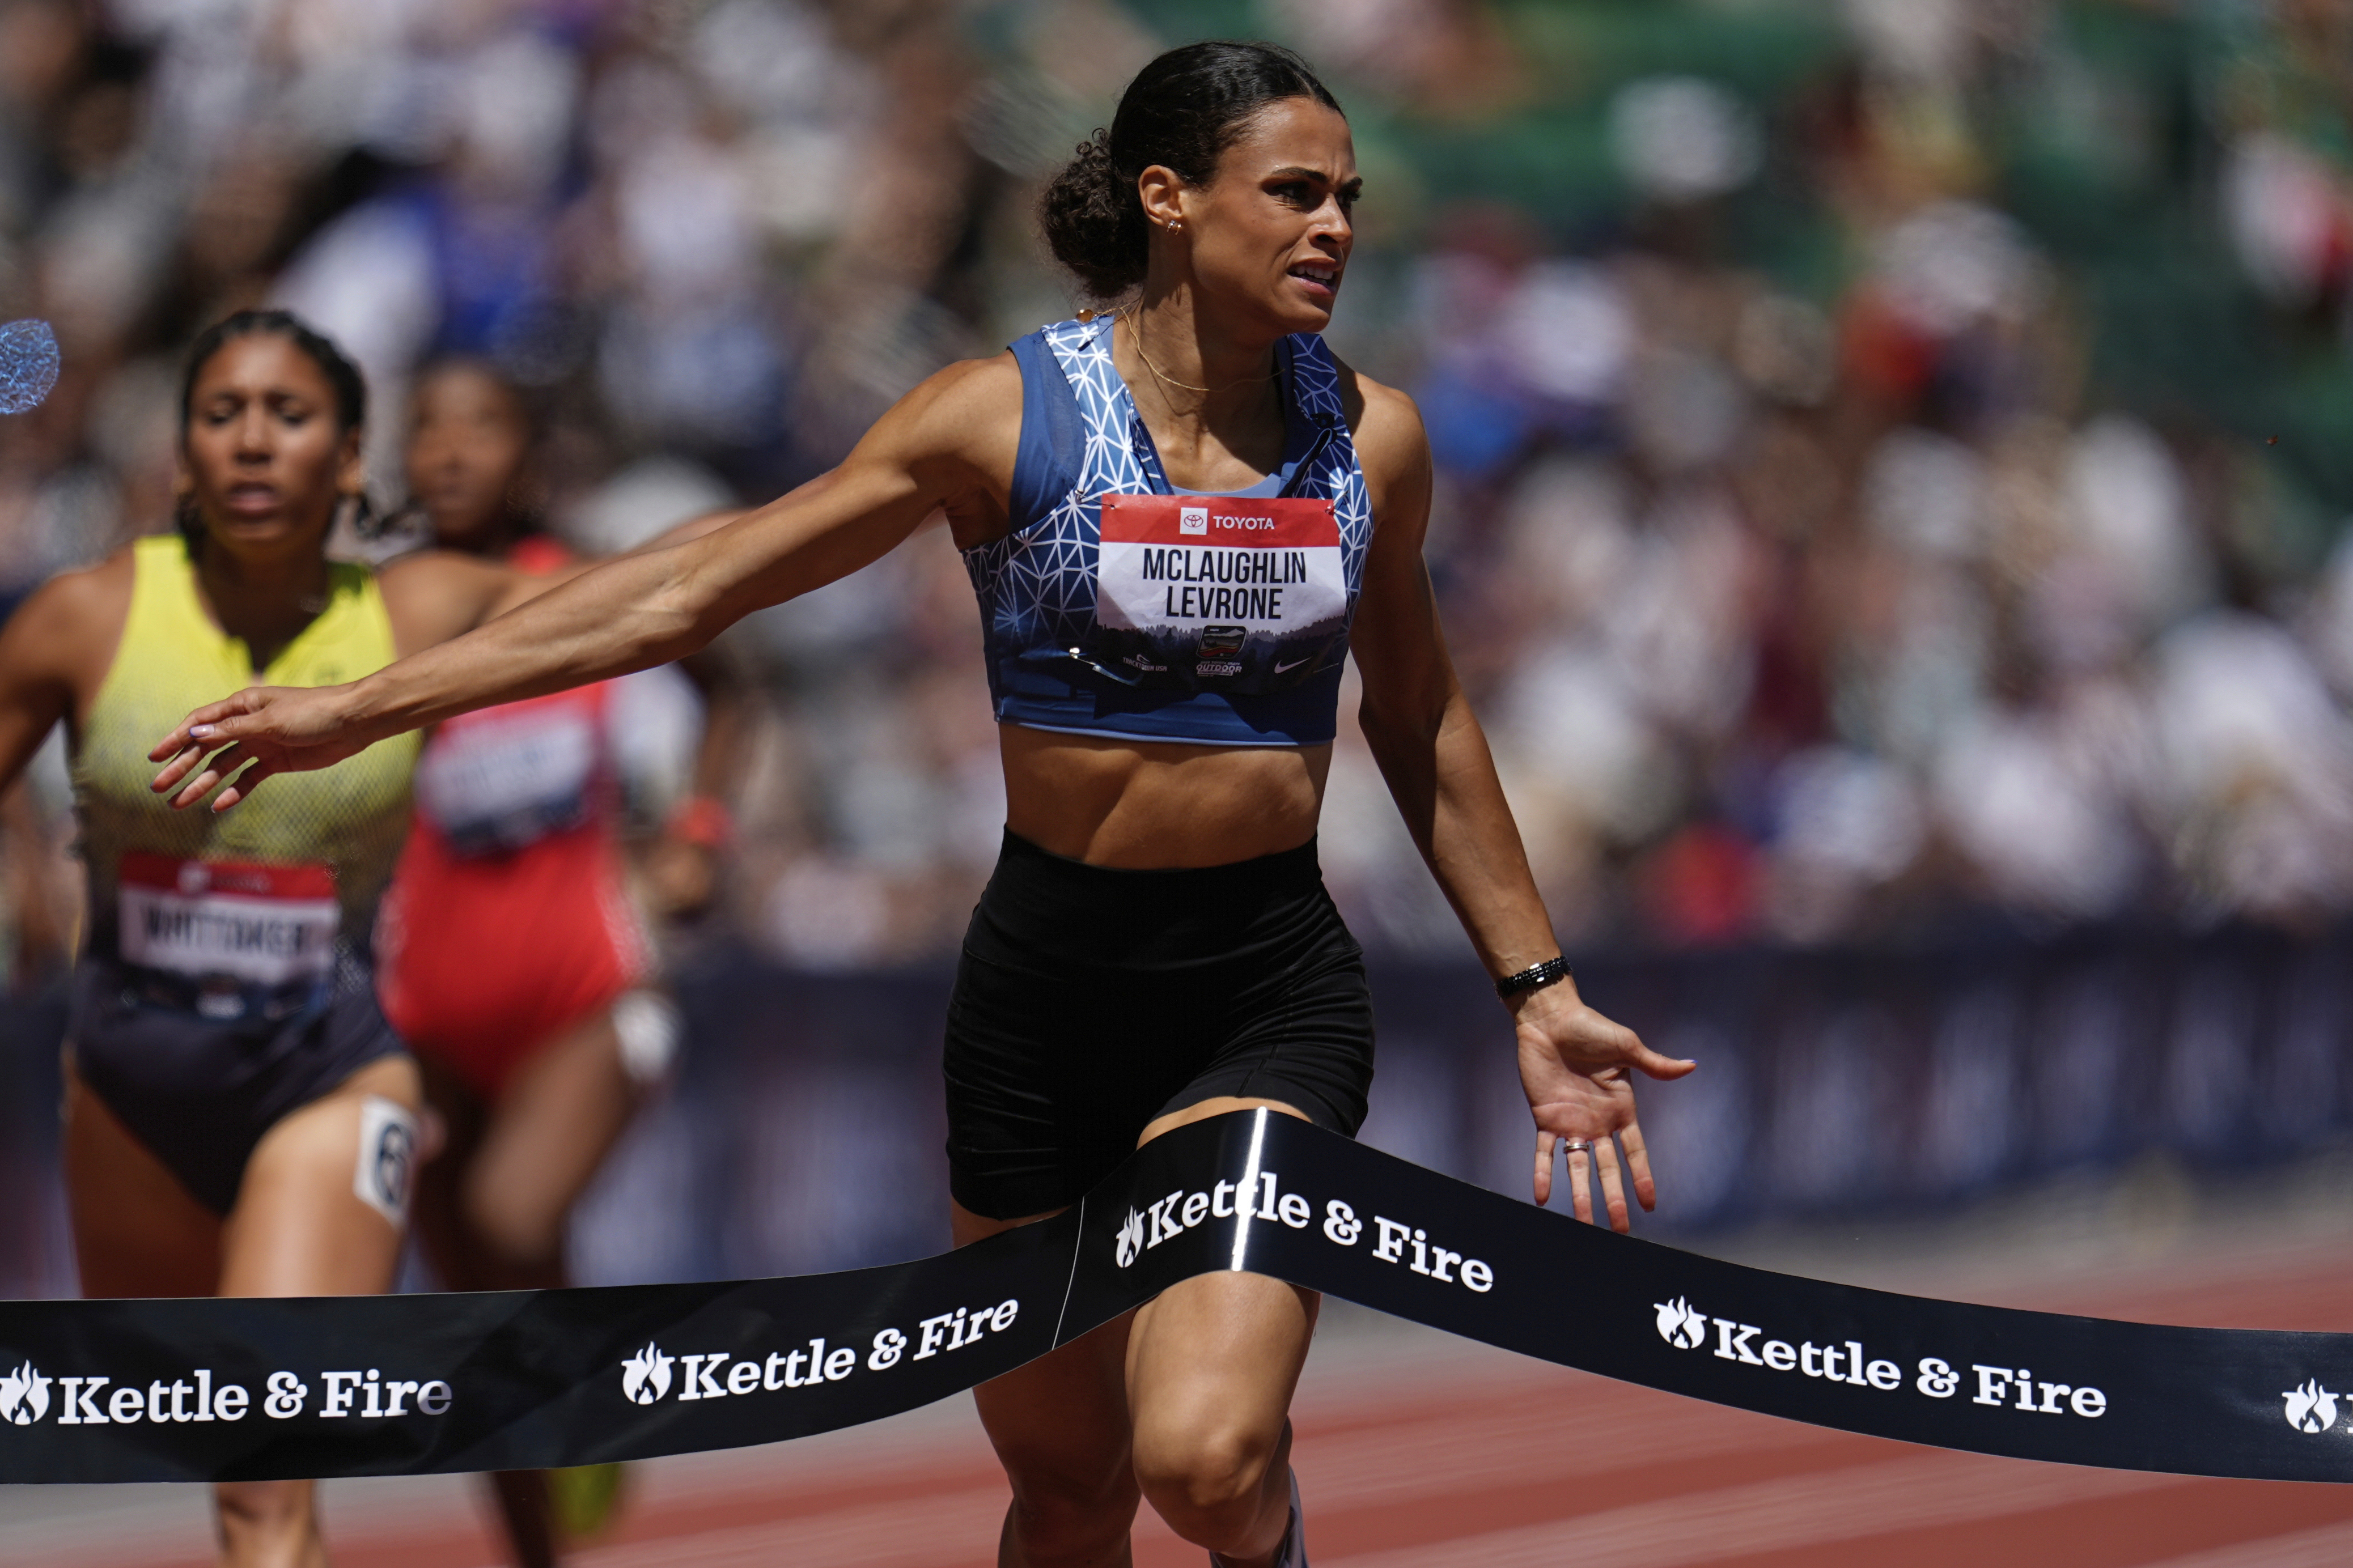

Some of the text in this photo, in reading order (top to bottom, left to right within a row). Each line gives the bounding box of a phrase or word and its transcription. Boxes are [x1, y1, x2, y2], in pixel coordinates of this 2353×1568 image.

[1212, 516, 1275, 530] TOYOTA
[1143, 548, 1307, 584] MCLAUGHLIN
[1165, 586, 1282, 619] LEVRONE
[1196, 664, 1242, 673] OUTDOOR
[1146, 1171, 1494, 1293] Kettle & Fire
[677, 1298, 1019, 1401] Kettle & Fire
[57, 1368, 453, 1425] Kettle & Fire
[1711, 1340, 2108, 1418] Kettle & Fire
